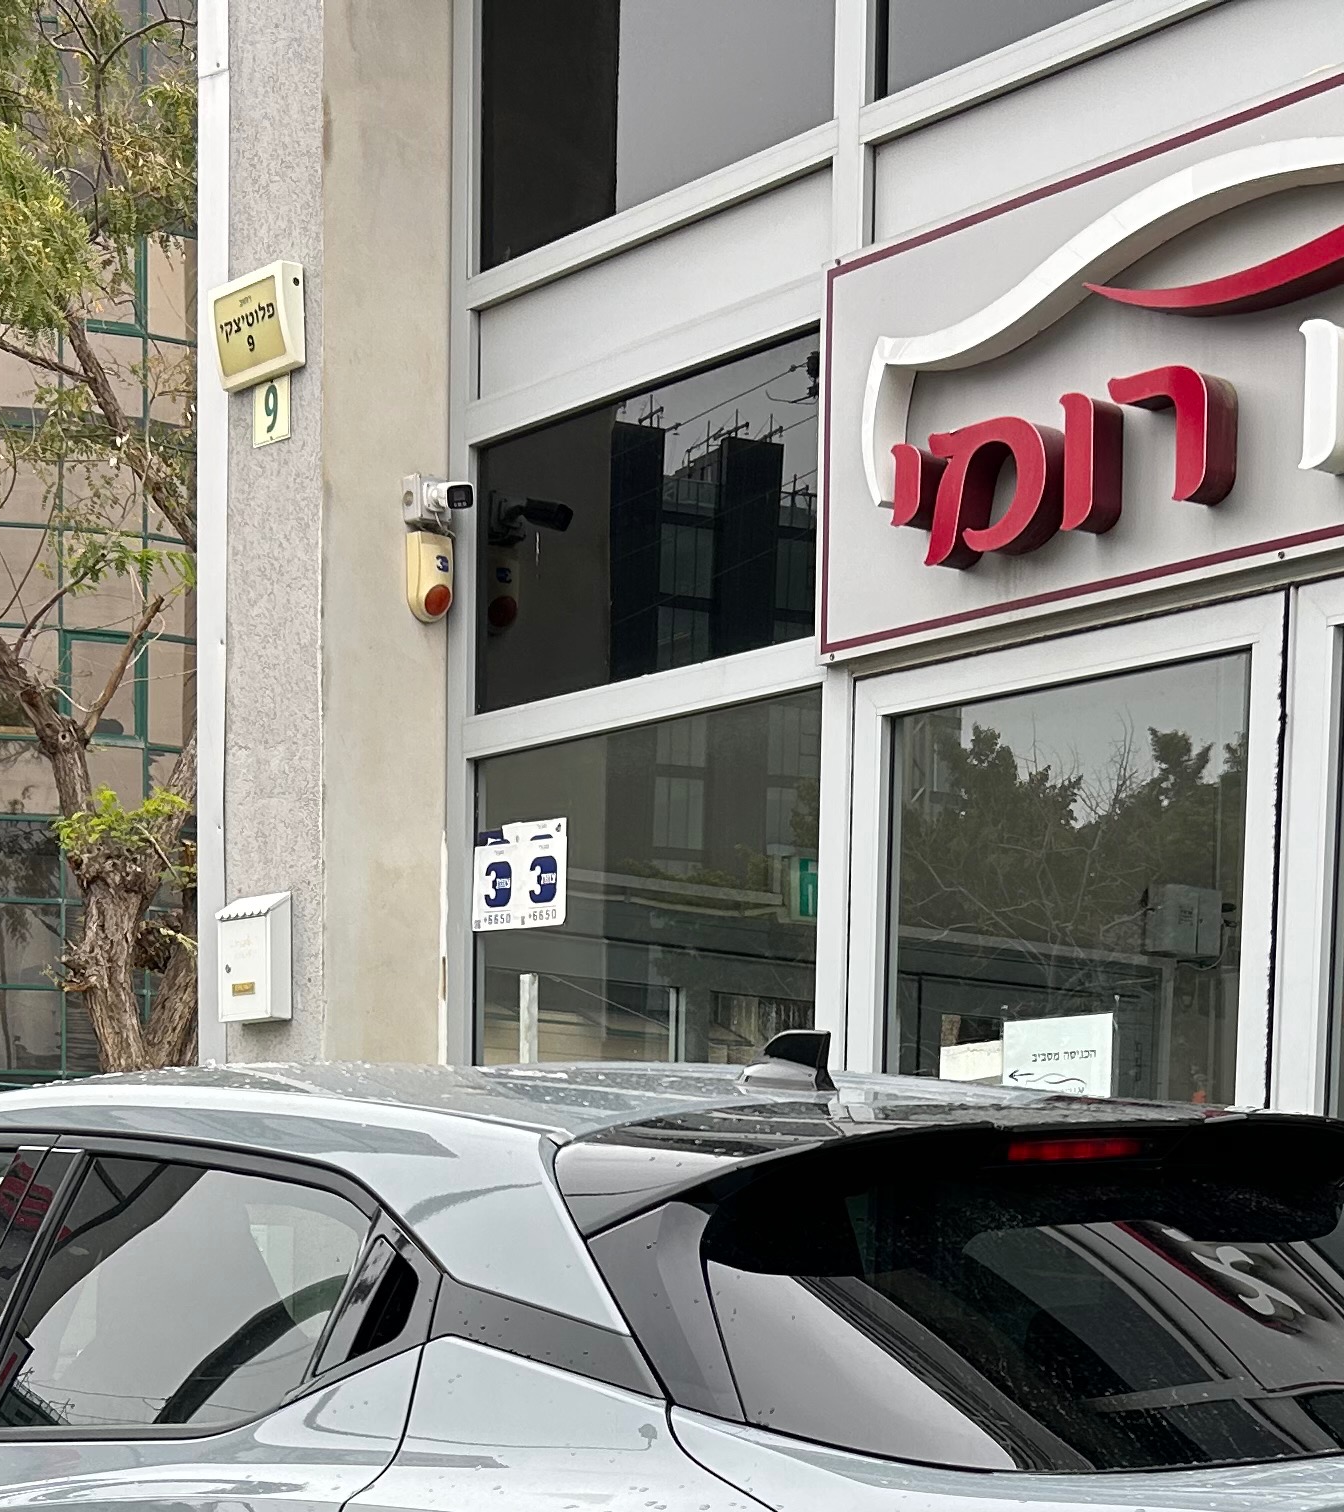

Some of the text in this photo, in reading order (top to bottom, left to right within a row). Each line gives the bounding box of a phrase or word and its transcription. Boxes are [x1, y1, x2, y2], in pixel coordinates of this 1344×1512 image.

[219, 302, 275, 343] פלוטיצקי
[247, 335, 255, 352] 9
[265, 385, 278, 433] 9
[891, 365, 1238, 571] רומי
[1031, 1049, 1096, 1063] הכניסה מסביב
